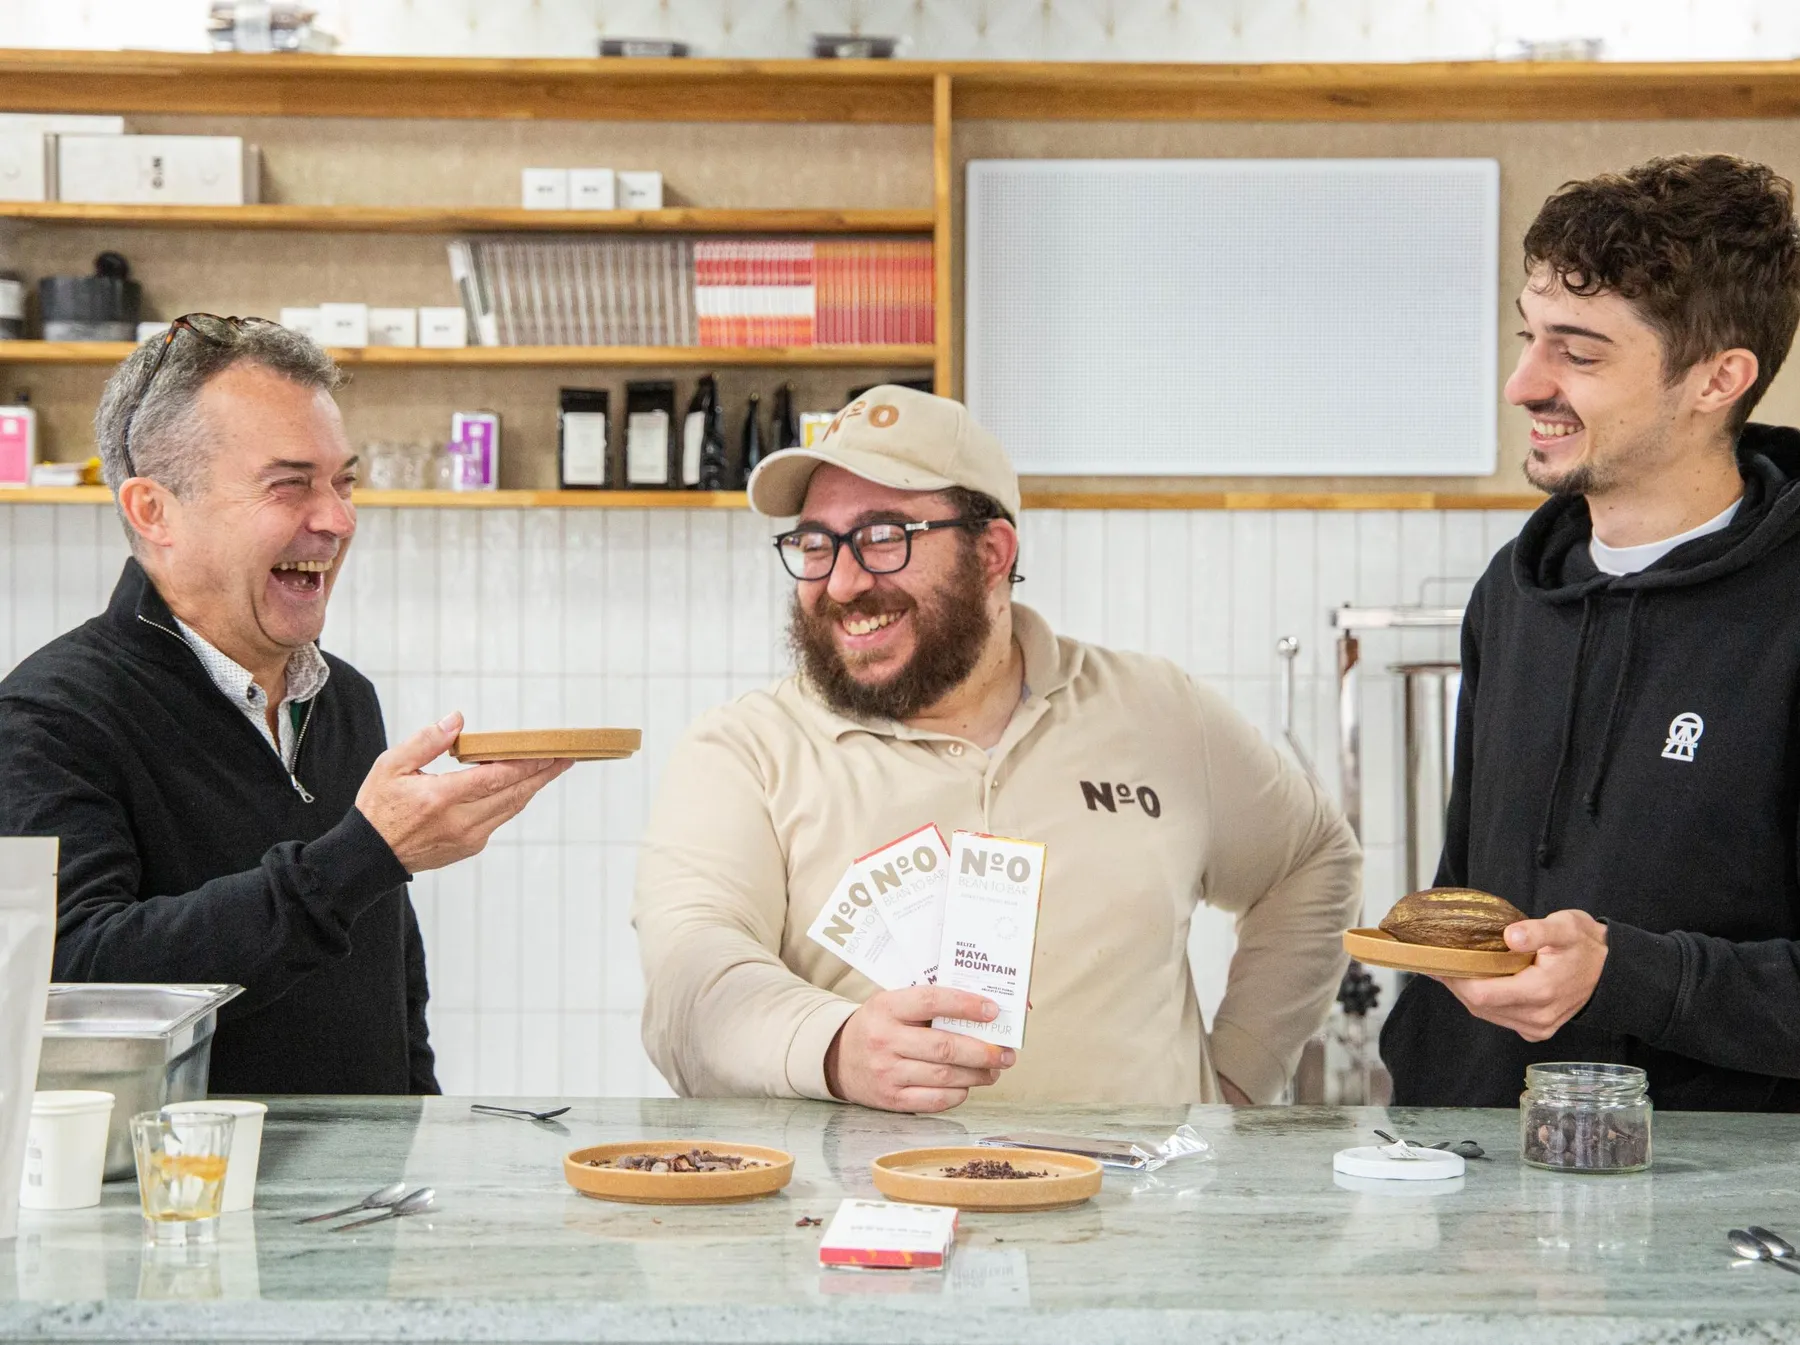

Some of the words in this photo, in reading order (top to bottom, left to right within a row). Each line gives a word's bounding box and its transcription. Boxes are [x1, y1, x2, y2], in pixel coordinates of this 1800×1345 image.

[883, 887, 911, 907] BEAN
[910, 878, 926, 893] TO
[925, 868, 947, 886] BAR
[959, 876, 988, 891] BEAN
[991, 880, 1005, 894] TO
[1006, 884, 1028, 896] BAR
[956, 941, 976, 949] BELIZE
[955, 948, 988, 961] MAYA
[954, 958, 1017, 976] MOUNTAIN
[990, 1021, 1013, 1037] PUR
